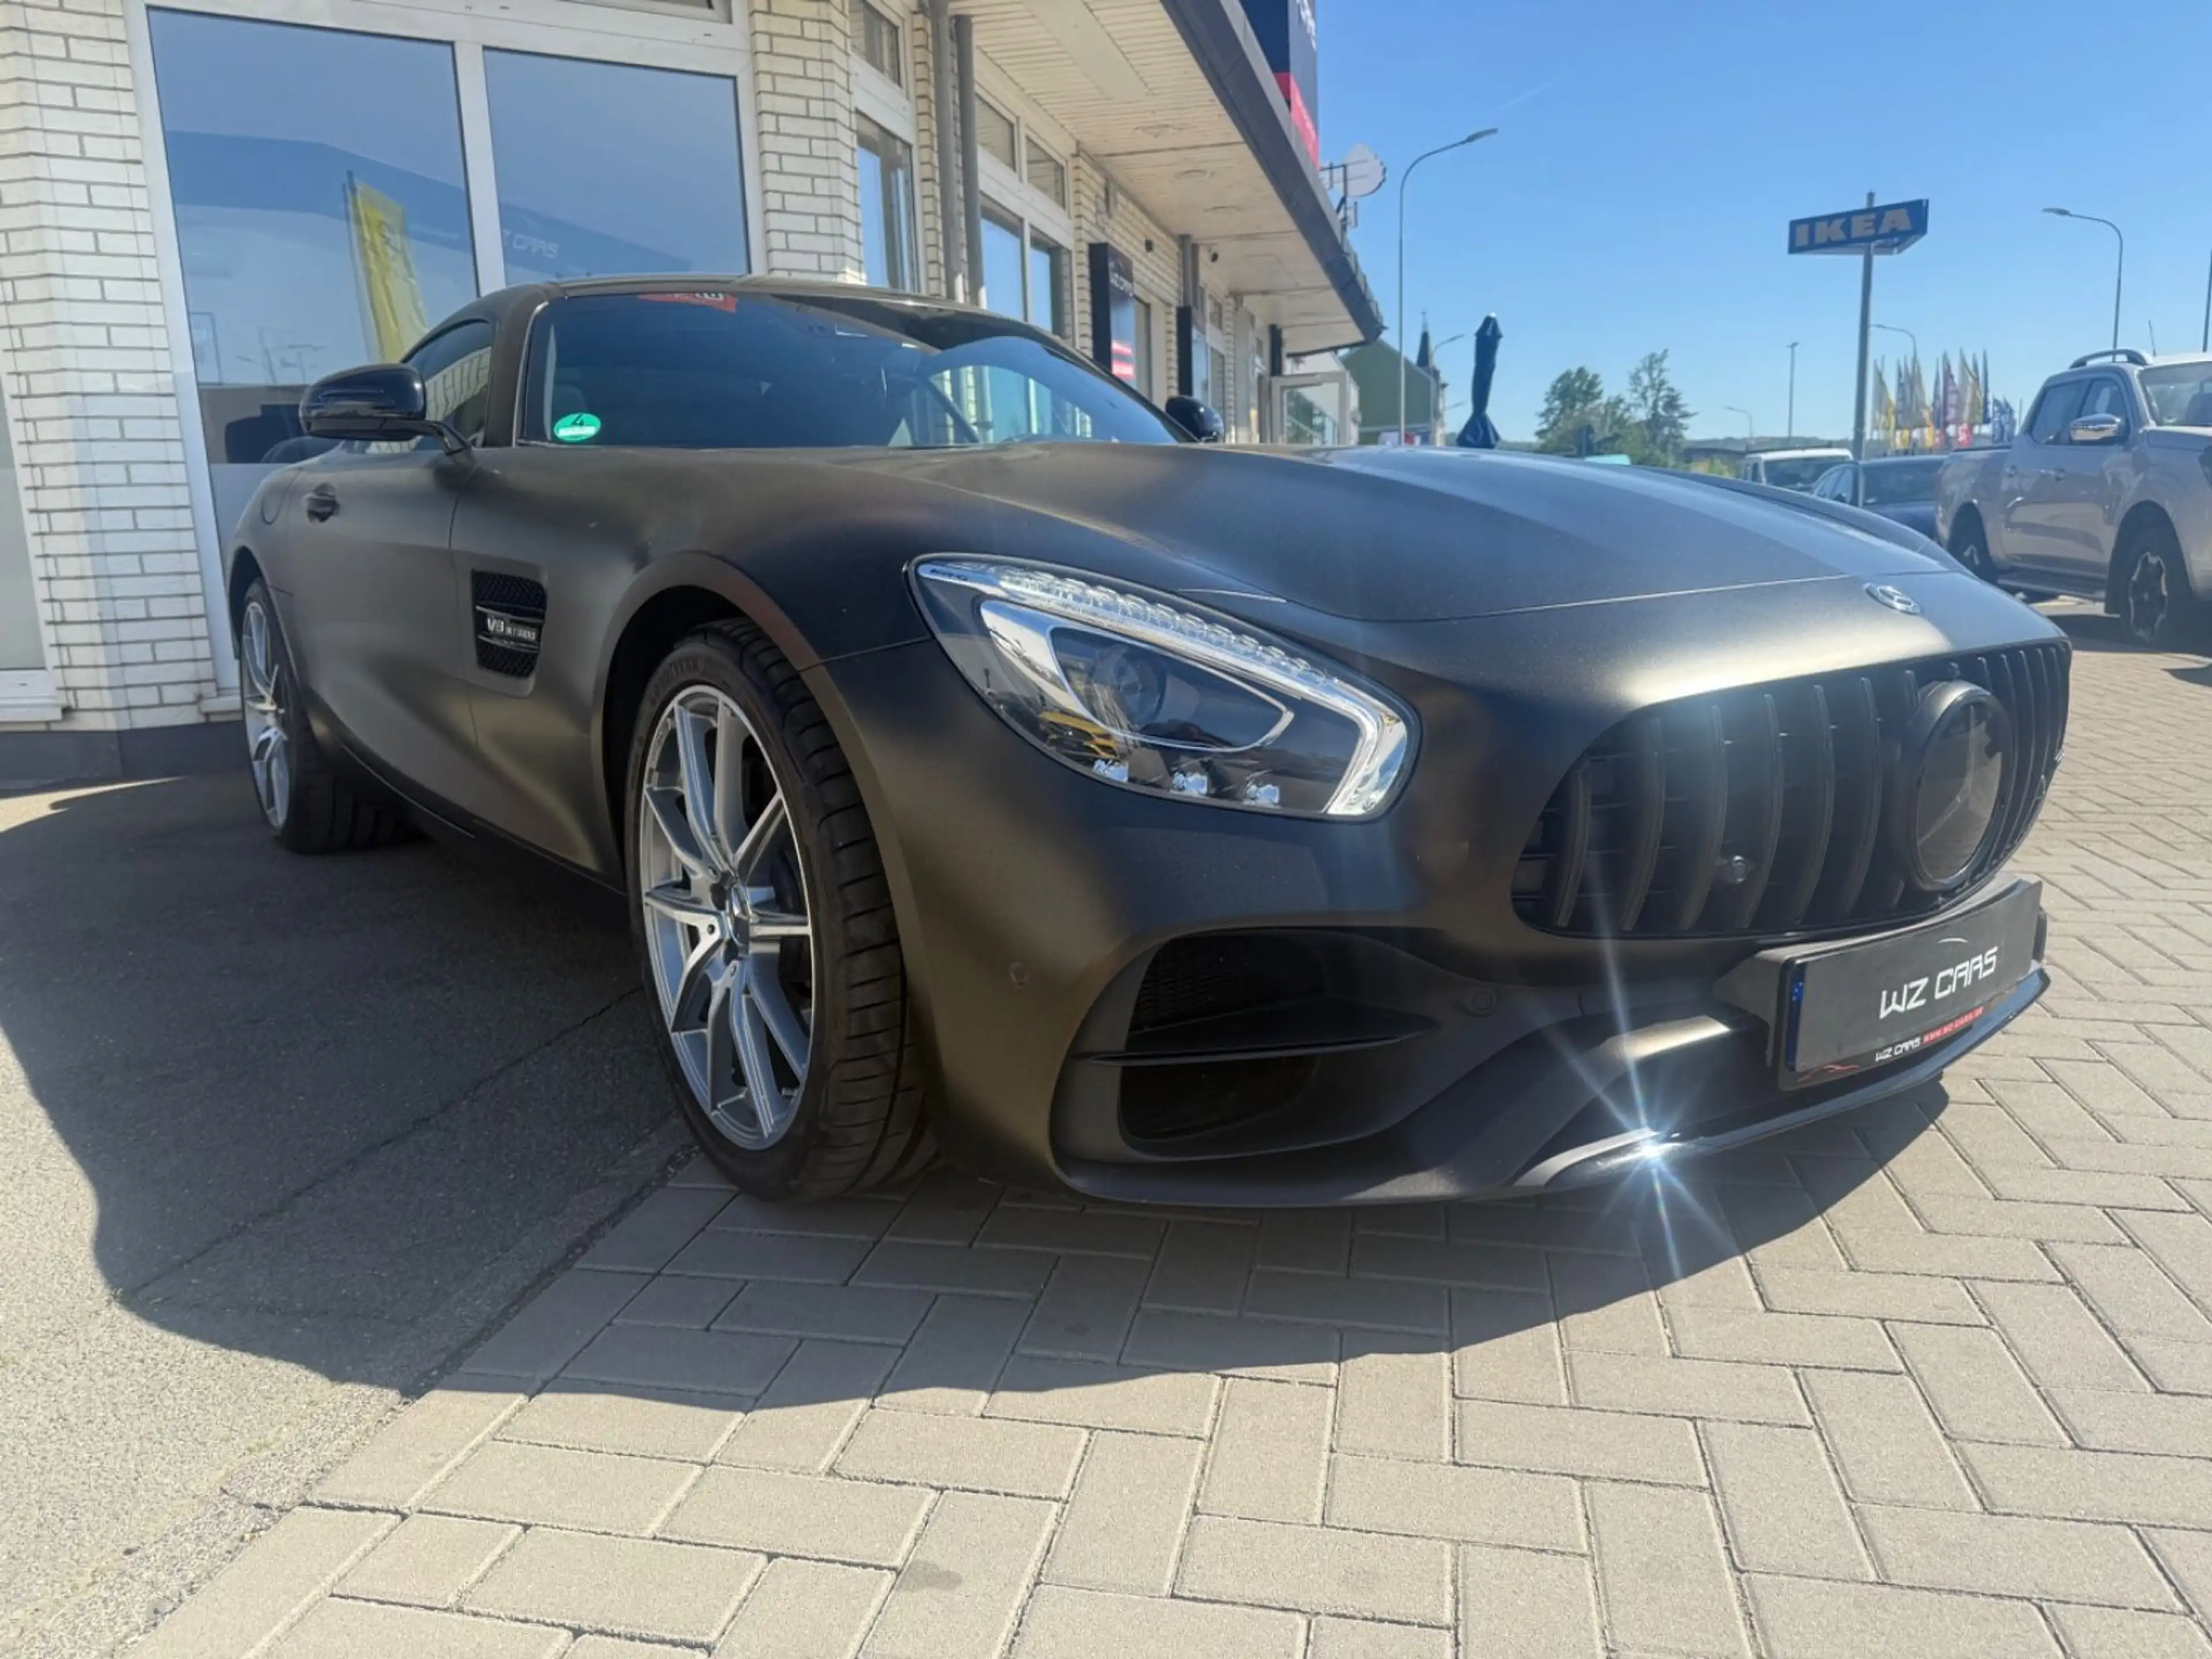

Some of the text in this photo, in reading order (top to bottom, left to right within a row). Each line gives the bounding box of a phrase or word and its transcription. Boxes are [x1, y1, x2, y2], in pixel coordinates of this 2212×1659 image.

[1795, 208, 1912, 247] IKEA
[1879, 946, 1998, 1019] WZ CARS
